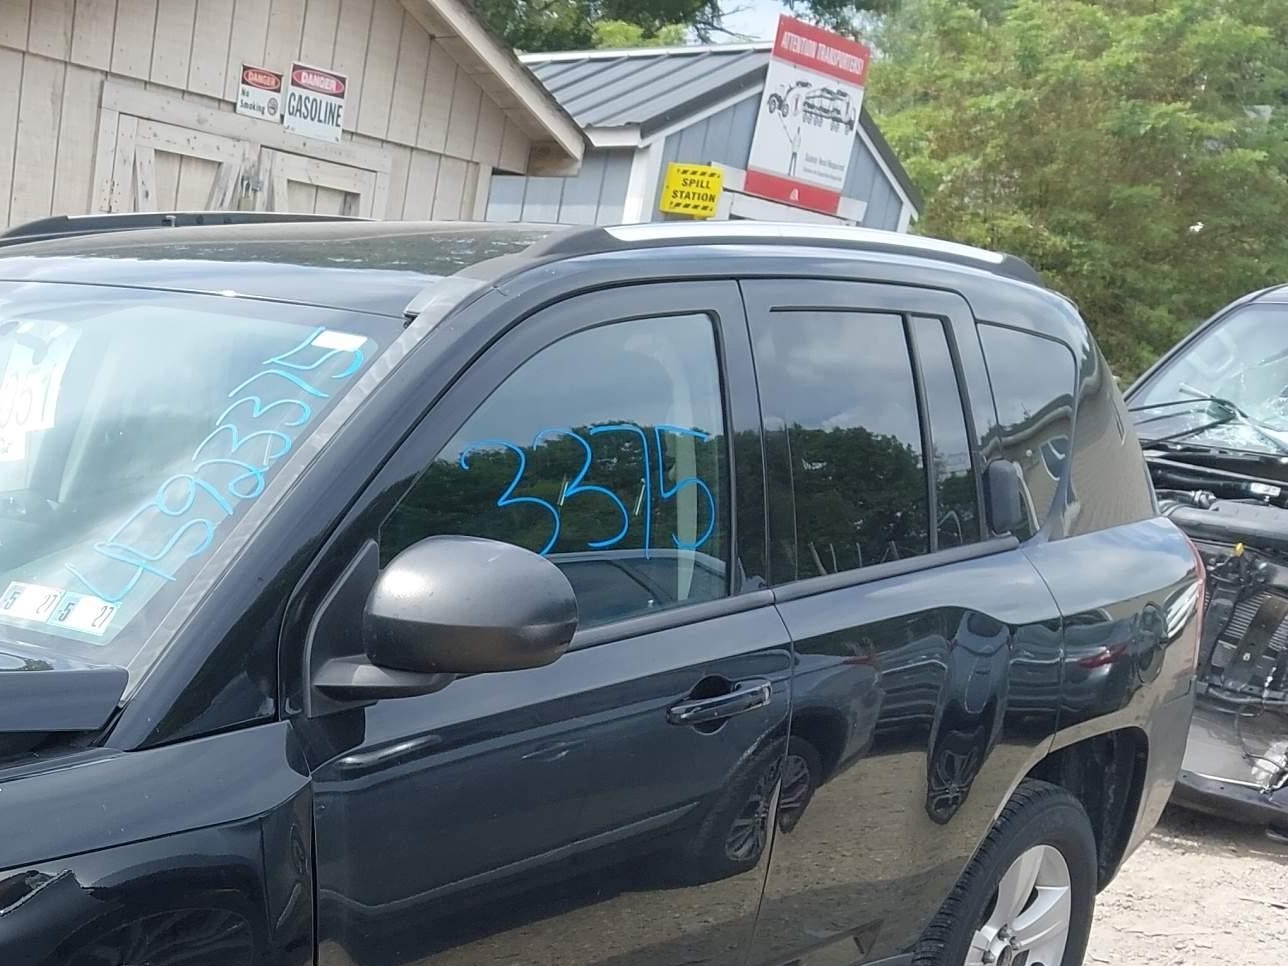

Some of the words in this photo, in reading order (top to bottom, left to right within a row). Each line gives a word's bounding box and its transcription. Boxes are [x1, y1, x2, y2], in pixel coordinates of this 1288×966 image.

[781, 31, 818, 59] ATTENTION
[248, 71, 276, 87] DANGER
[301, 72, 337, 92] DANGER
[240, 99, 265, 115] Smoking
[287, 91, 343, 127] GASOLINE
[682, 177, 711, 189] SPILL
[672, 190, 716, 203] STATION
[459, 422, 716, 560] 3375
